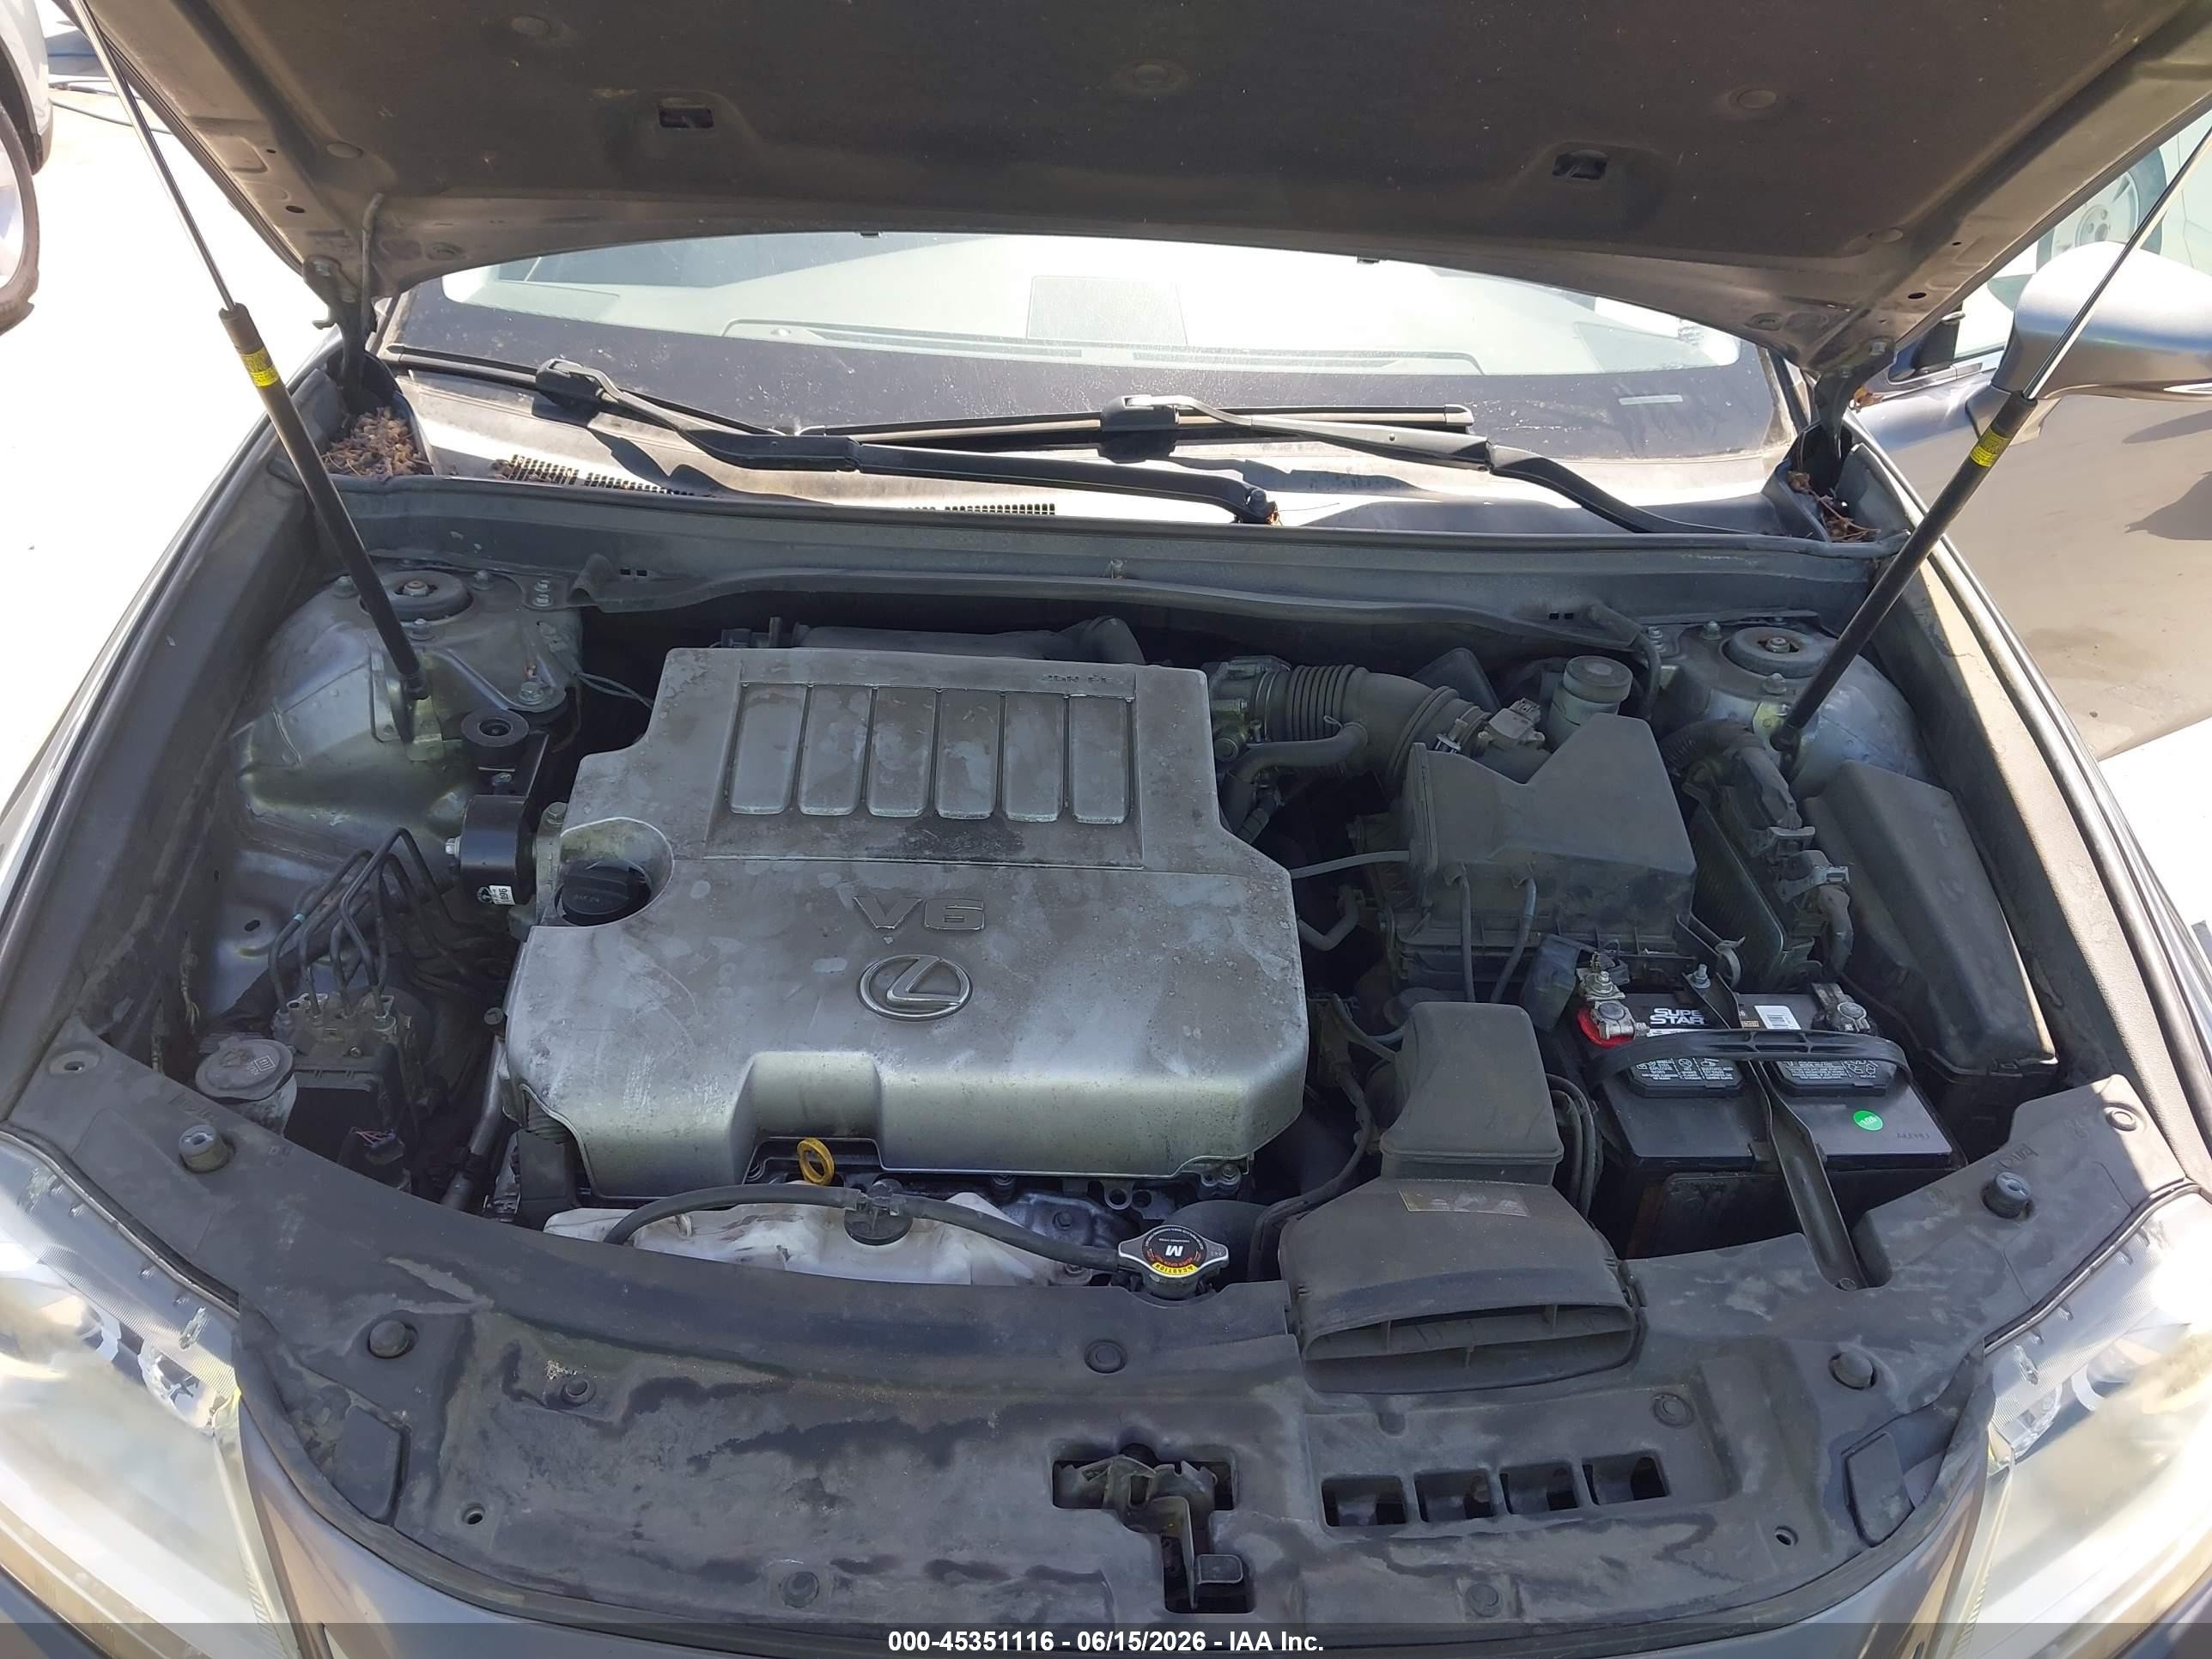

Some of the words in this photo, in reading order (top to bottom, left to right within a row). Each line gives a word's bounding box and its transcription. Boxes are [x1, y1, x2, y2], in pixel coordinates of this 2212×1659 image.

[853, 896, 985, 931] V6
[1652, 1008, 1703, 1017] SUPE
[1649, 1016, 1705, 1024] STAR
[1165, 1245, 1183, 1256] M
[1155, 1264, 1188, 1274] CAUTION
